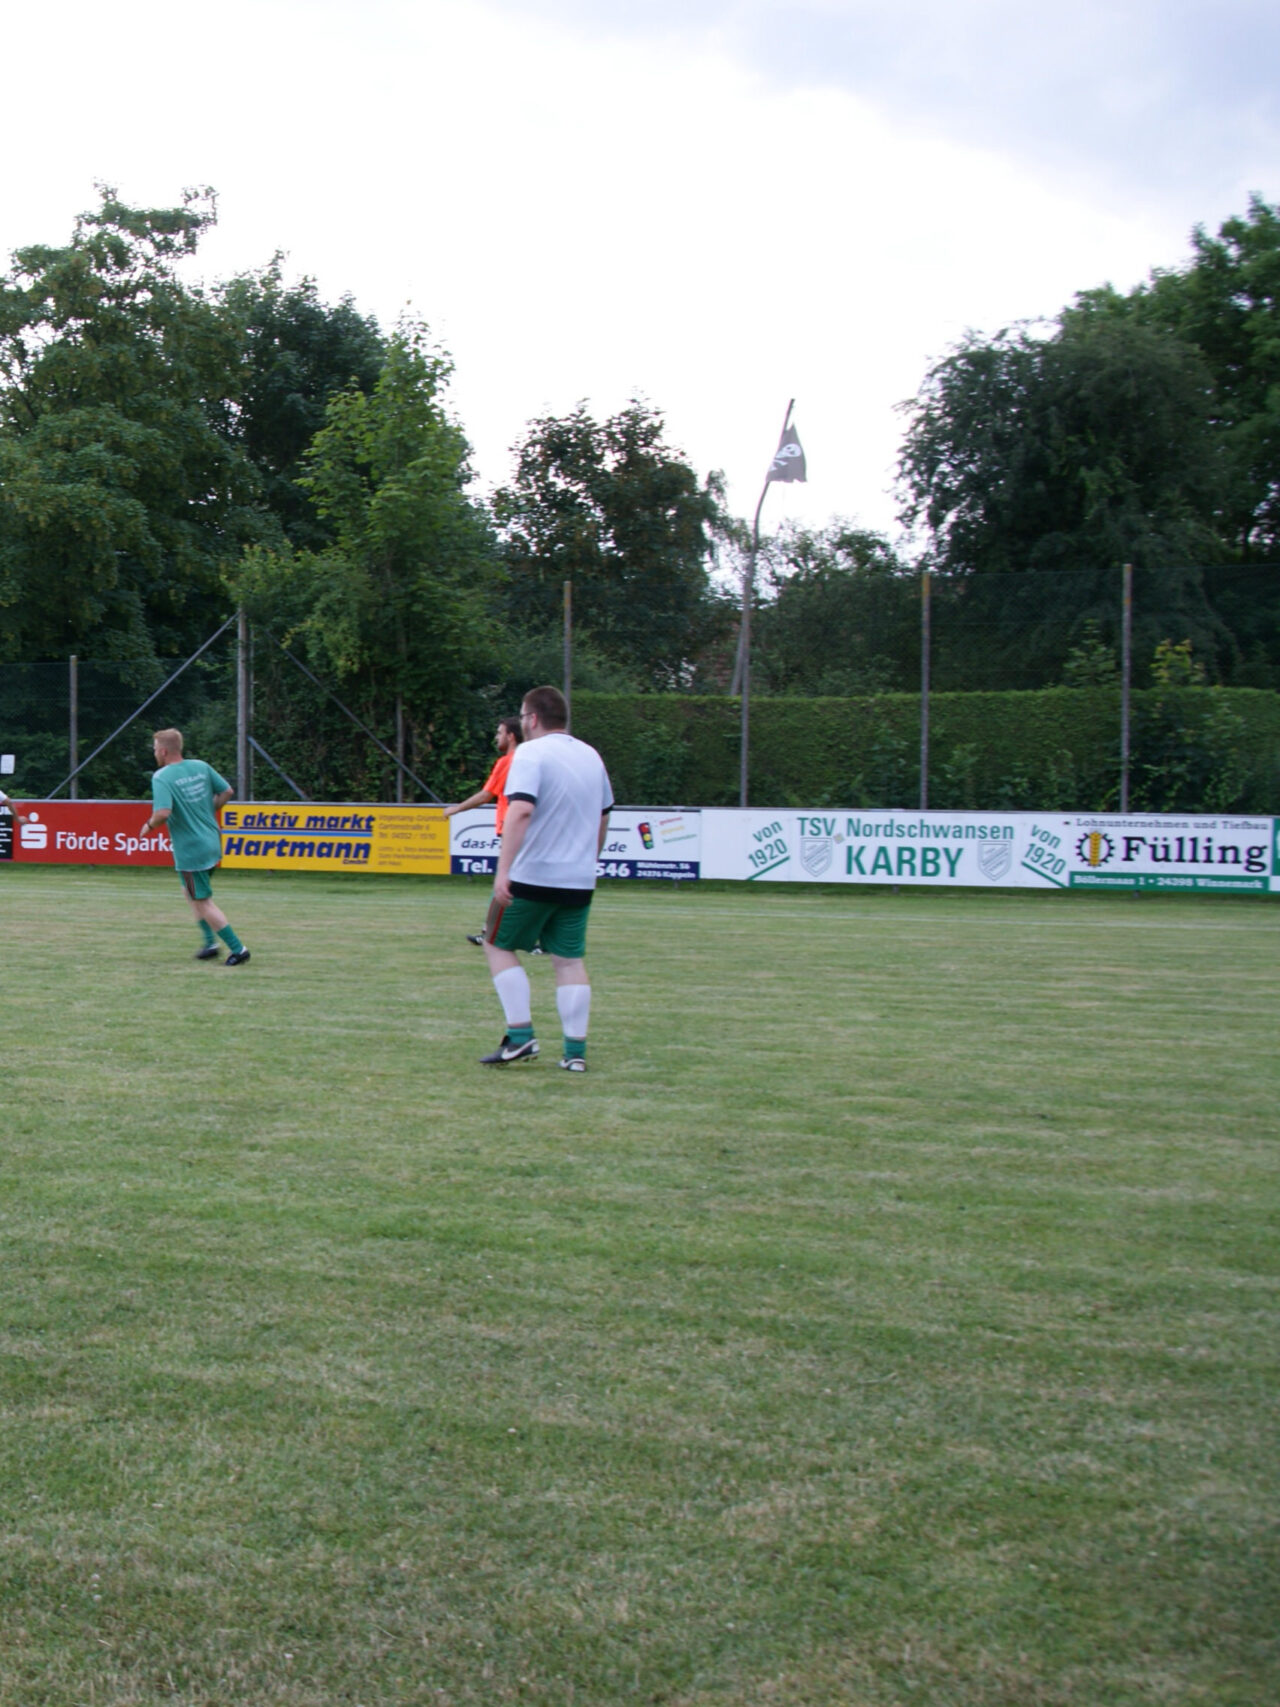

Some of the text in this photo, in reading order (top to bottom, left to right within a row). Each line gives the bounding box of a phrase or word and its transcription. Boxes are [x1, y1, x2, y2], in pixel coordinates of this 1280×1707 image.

[224, 811, 376, 831] E aktiv markt
[752, 820, 783, 844] von
[797, 816, 1014, 840] TSV Nordschwansen
[1076, 818, 1268, 830] Lohnunternehmen und Tiefbau
[56, 831, 109, 850] Förde
[225, 837, 371, 859] Hartmann
[461, 837, 502, 849] das-F
[1030, 824, 1061, 849] von
[748, 838, 788, 869] 1920
[846, 845, 964, 877] KARBY
[1024, 843, 1067, 876] 1920
[1122, 836, 1268, 873] Fülling
[460, 858, 492, 874] Tel.
